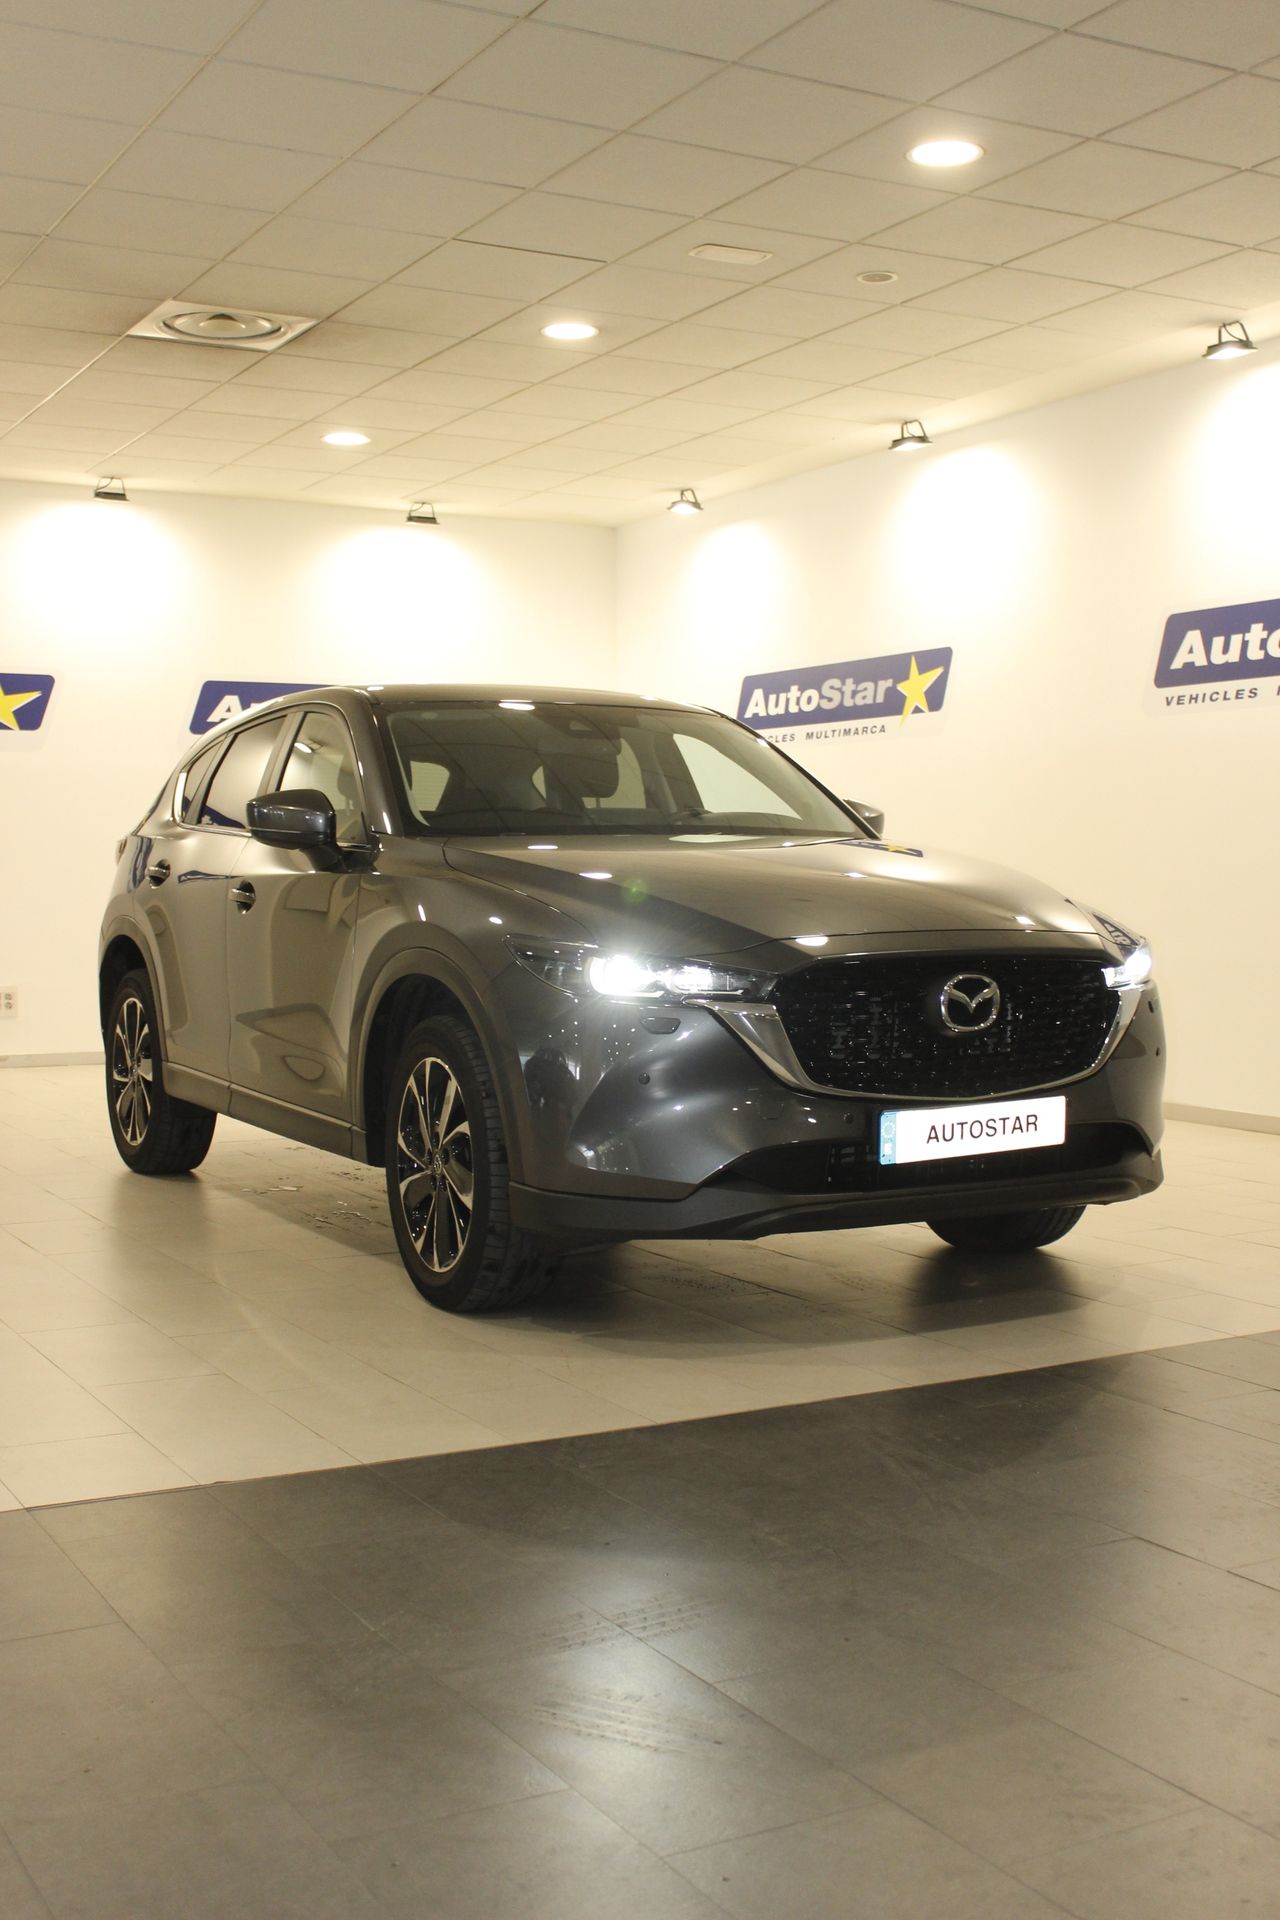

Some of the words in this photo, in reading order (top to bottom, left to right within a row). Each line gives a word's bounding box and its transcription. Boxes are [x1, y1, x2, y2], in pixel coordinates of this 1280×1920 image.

[743, 678, 894, 719] AutoStar
[1165, 687, 1259, 706] VEHICLES
[767, 733, 796, 743] CLES
[805, 724, 887, 741] MULTIMARCA
[926, 1113, 1039, 1145] AUTOSTAR
